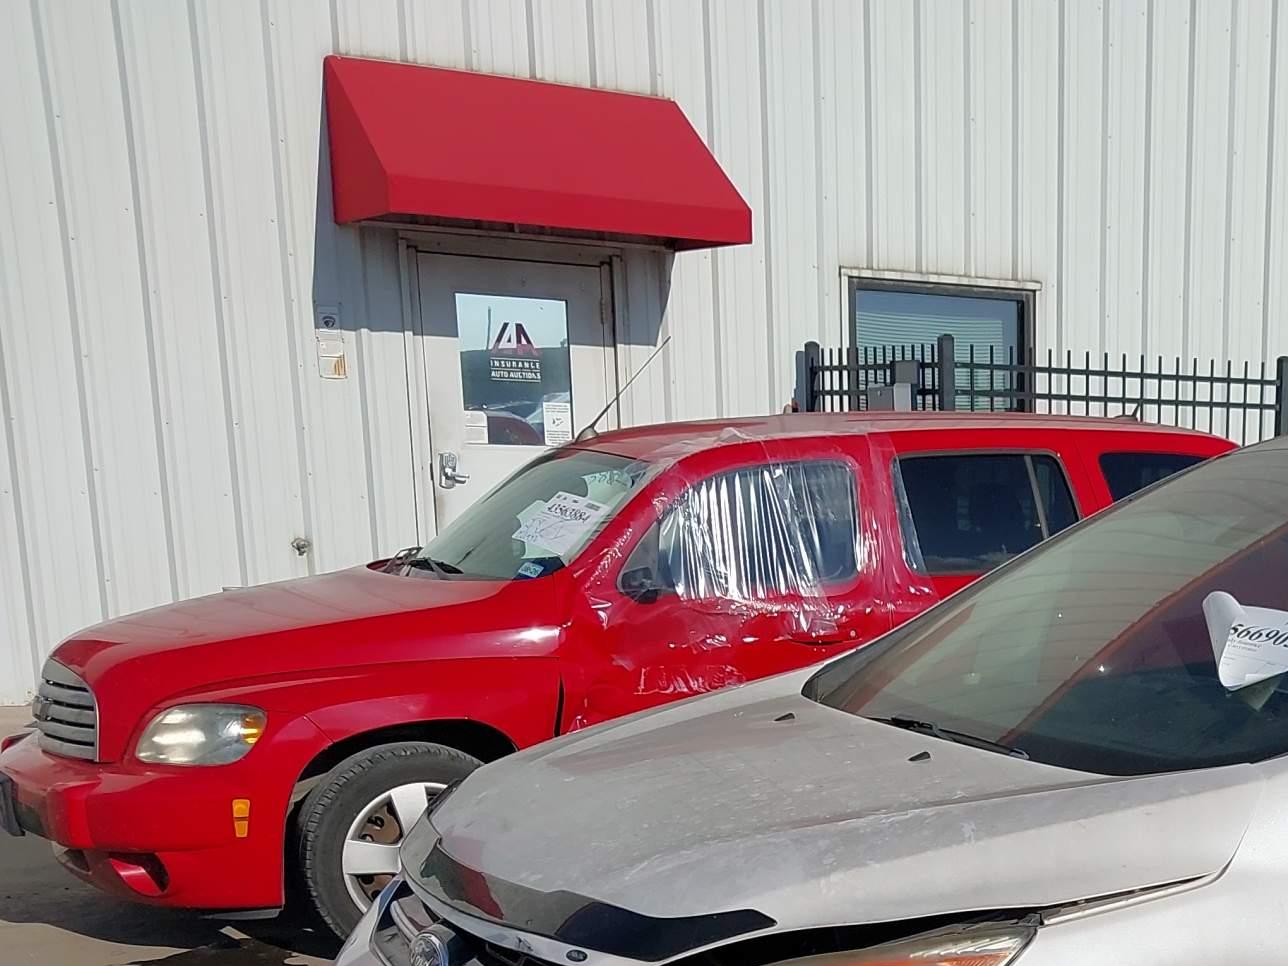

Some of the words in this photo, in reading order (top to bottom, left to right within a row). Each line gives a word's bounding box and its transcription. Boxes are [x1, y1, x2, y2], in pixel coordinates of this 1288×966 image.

[490, 359, 541, 370] INSURANCE
[491, 370, 509, 378] AUTO
[509, 371, 541, 379] AUCTIONS
